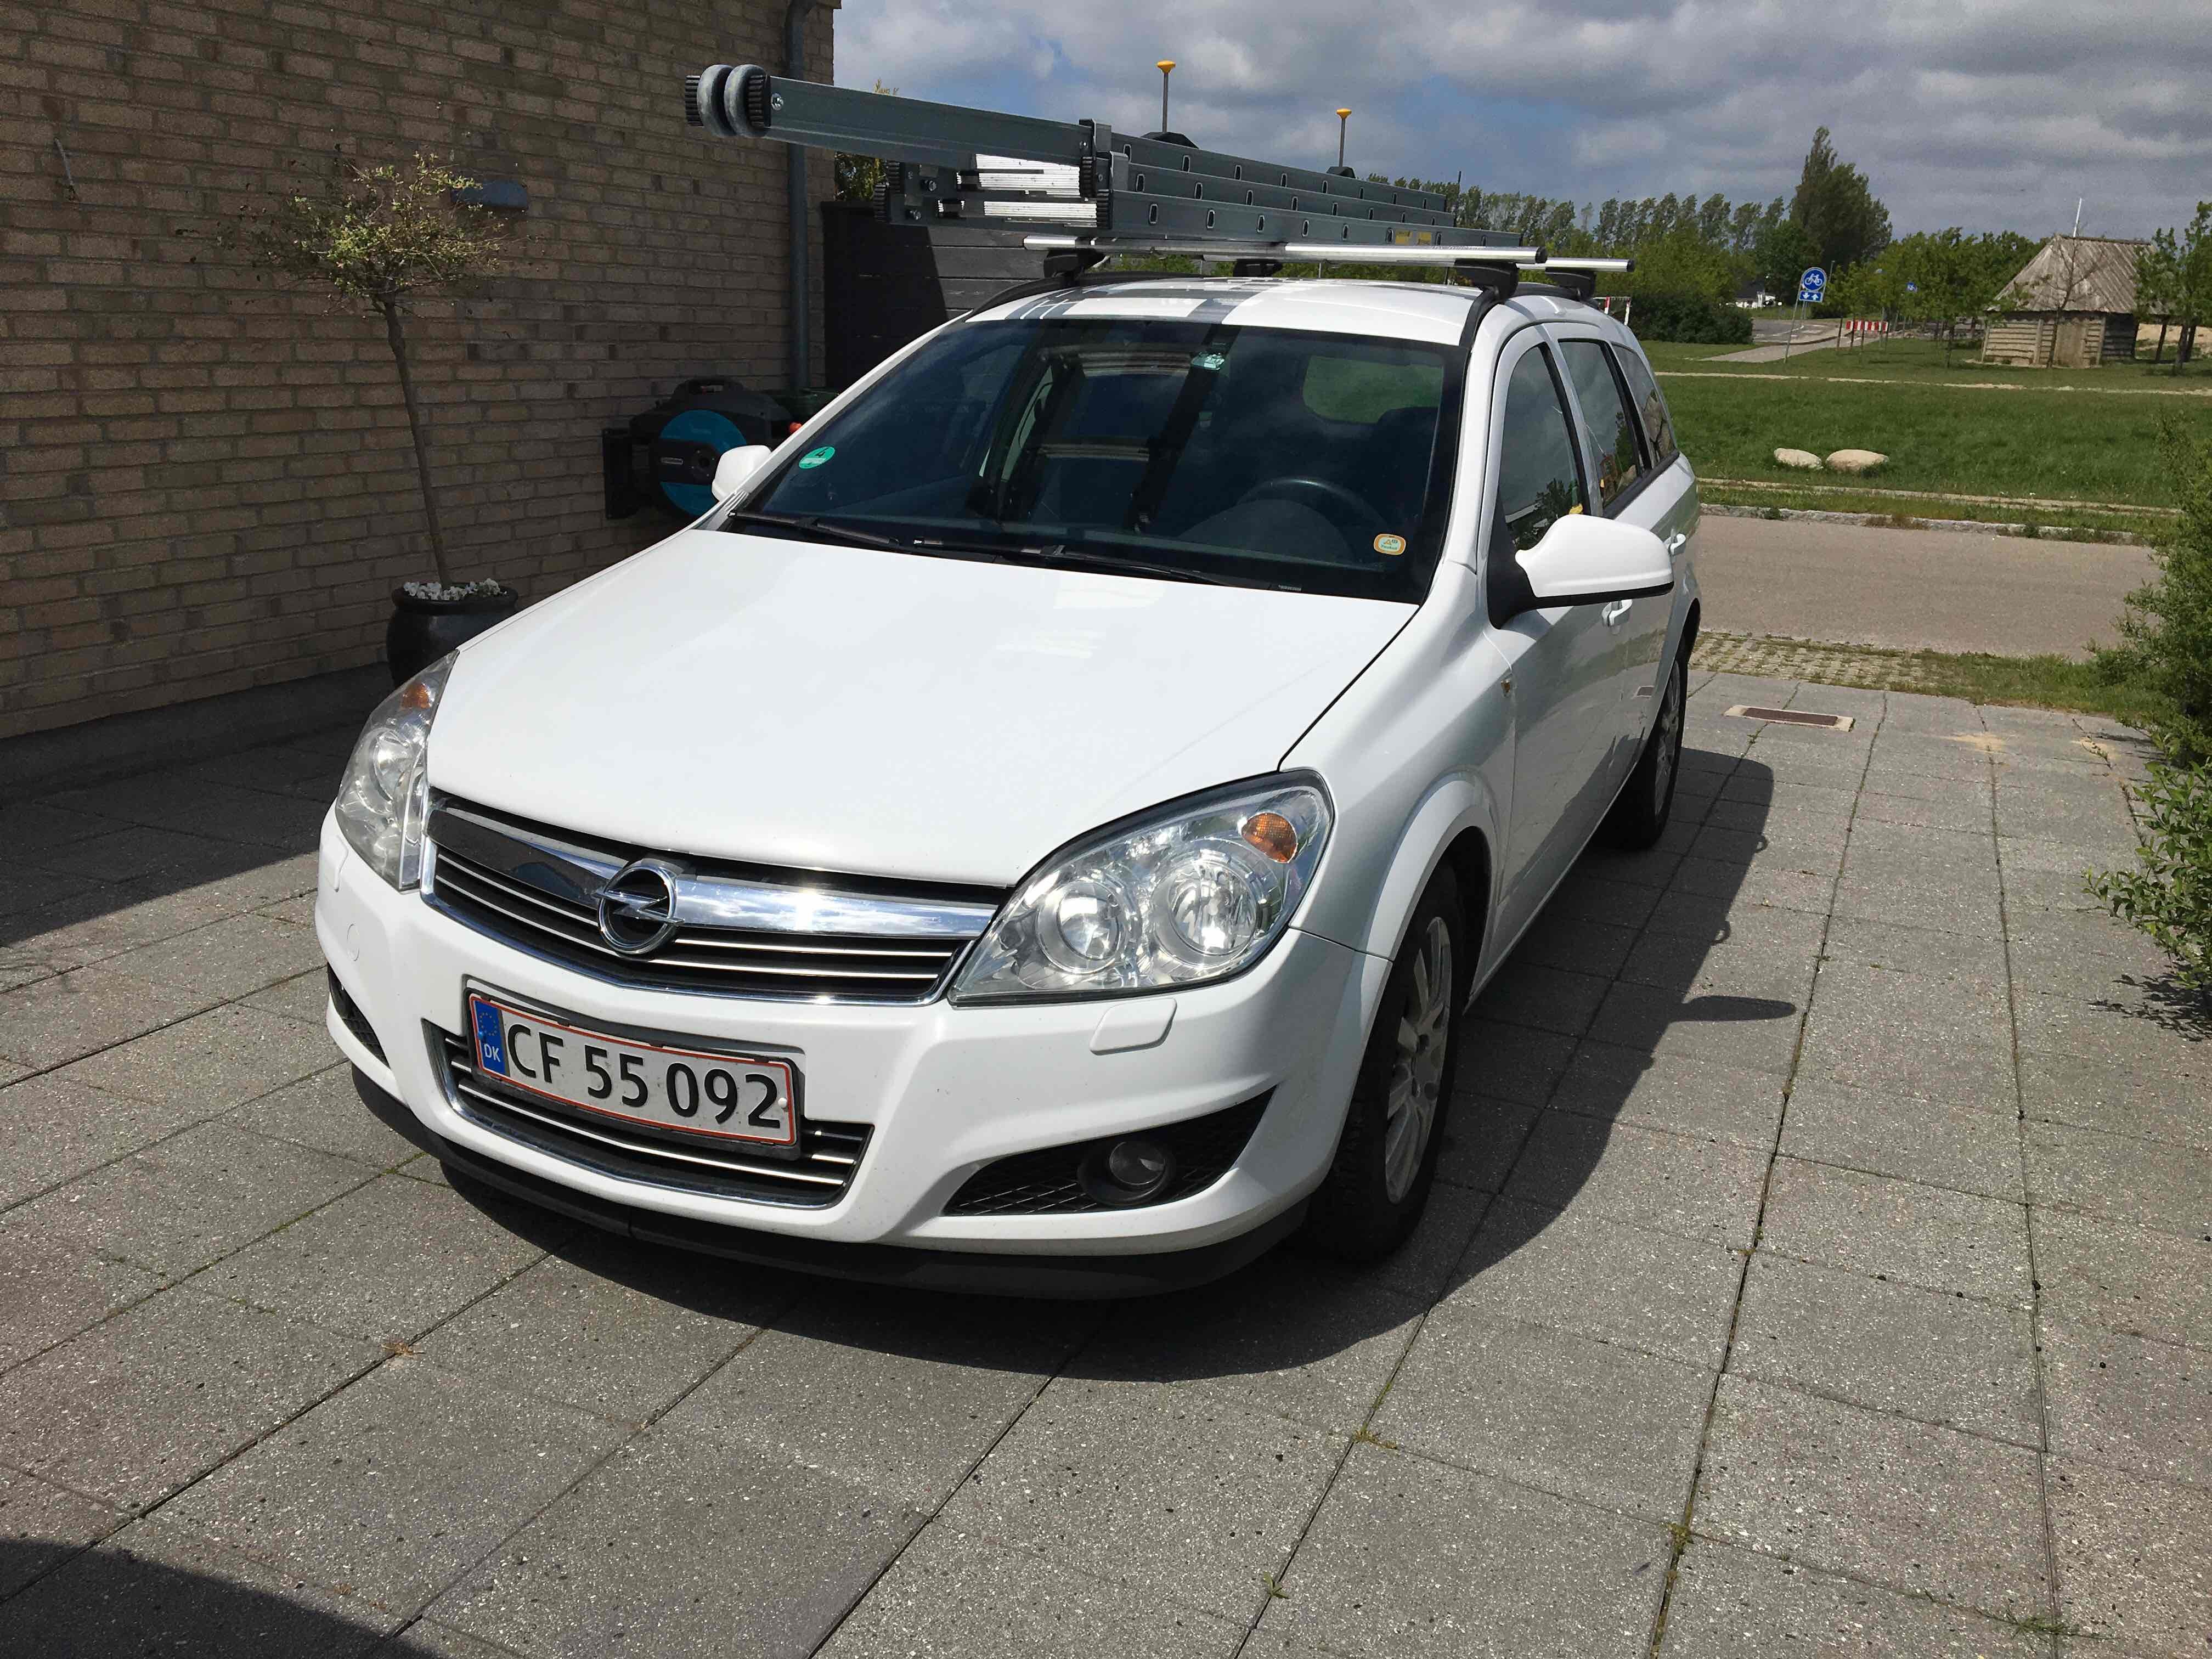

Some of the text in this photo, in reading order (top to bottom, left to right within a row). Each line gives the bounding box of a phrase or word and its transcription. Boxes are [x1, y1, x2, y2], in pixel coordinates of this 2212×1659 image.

[484, 1043, 500, 1062] DK
[507, 1024, 781, 1128] CF 55 092
